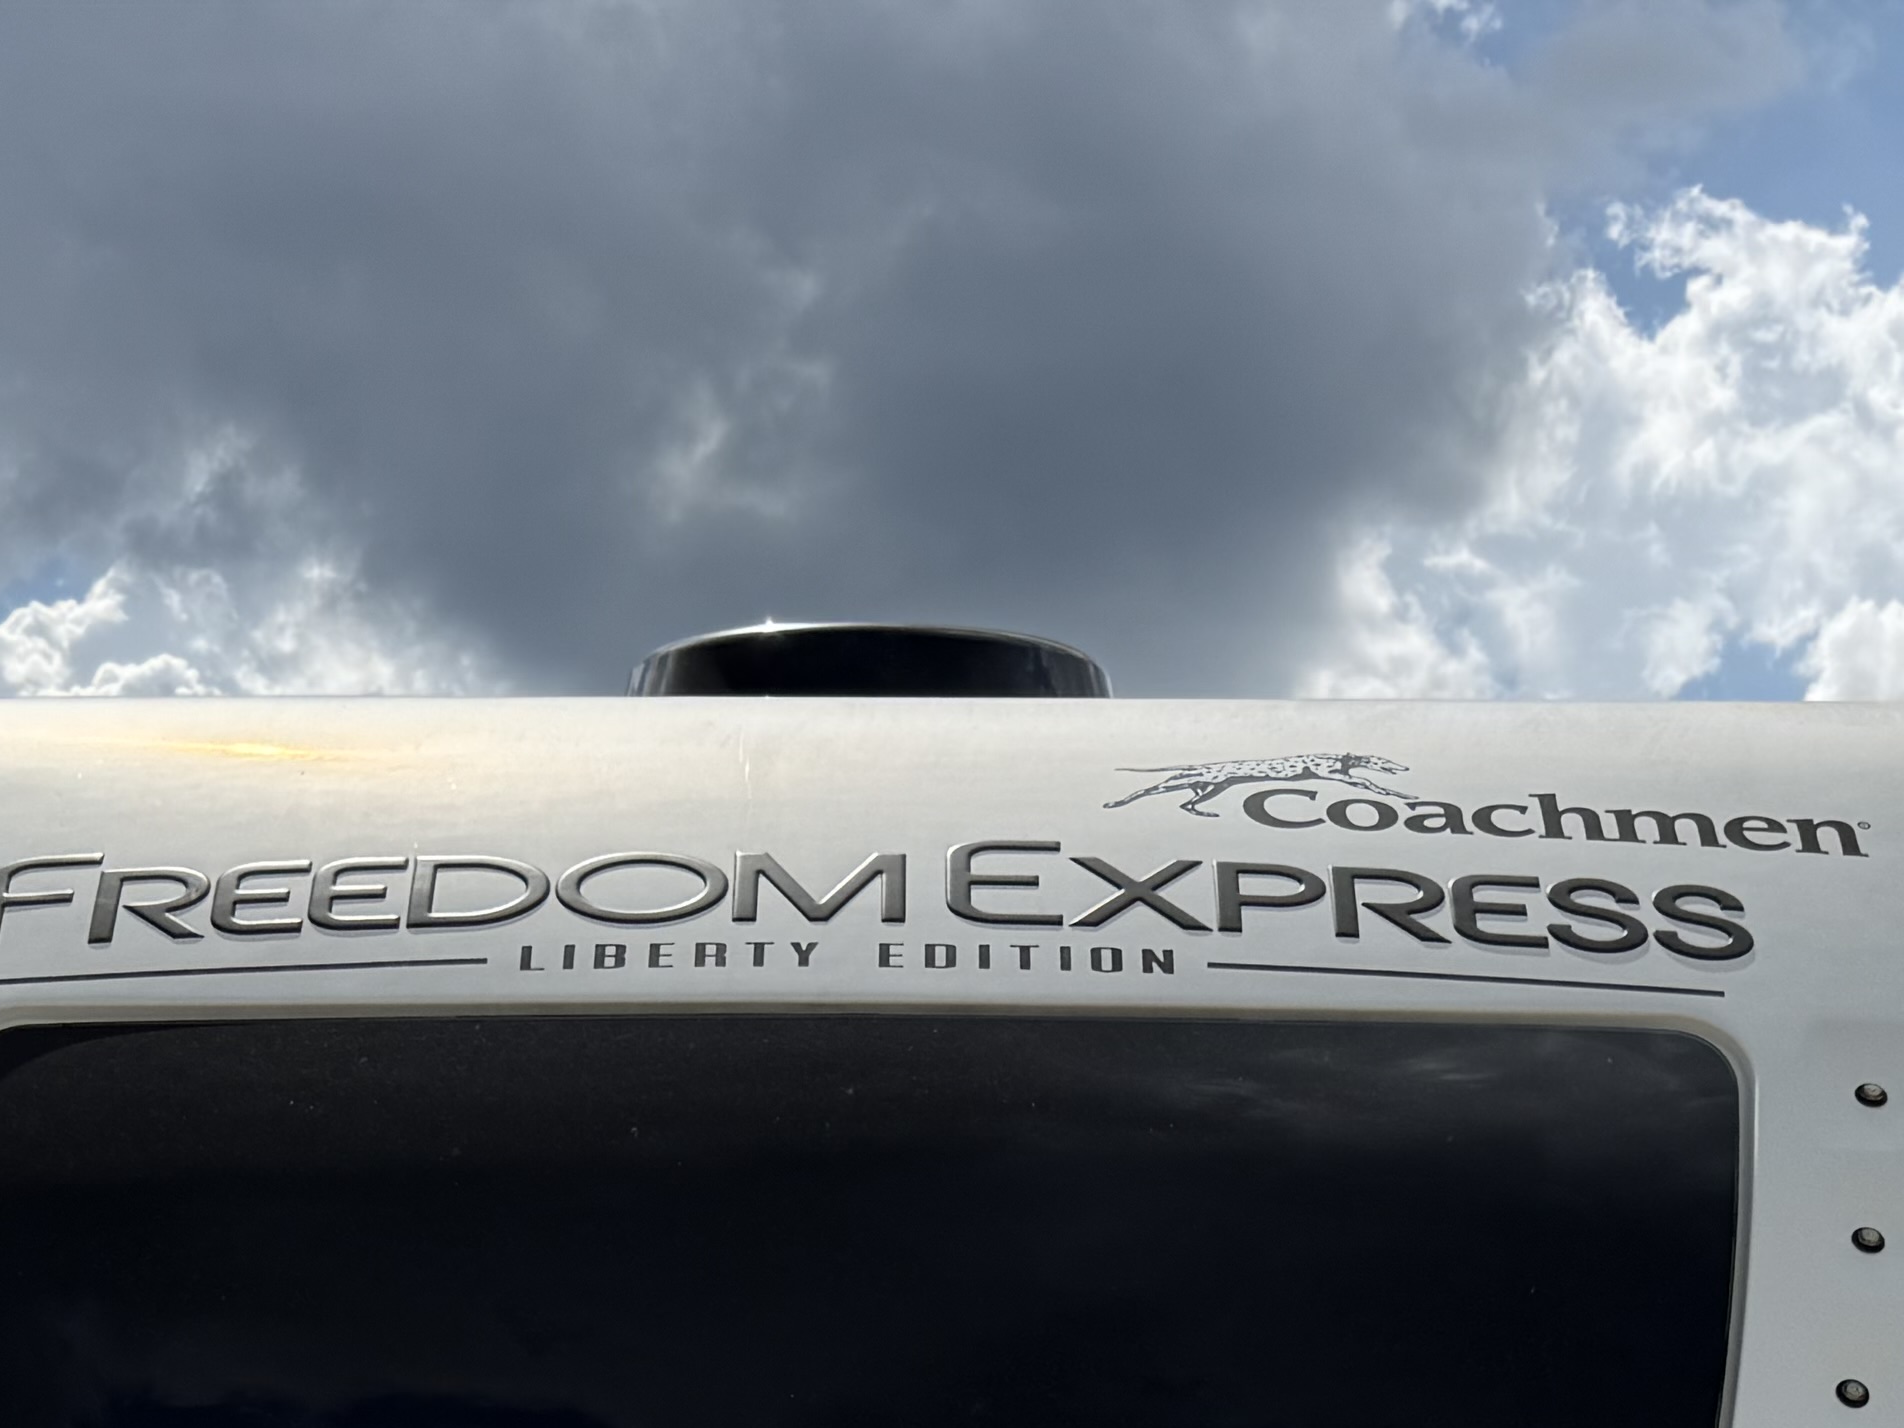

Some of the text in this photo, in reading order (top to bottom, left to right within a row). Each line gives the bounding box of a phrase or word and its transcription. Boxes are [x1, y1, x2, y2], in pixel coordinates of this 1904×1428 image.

[1242, 788, 1870, 858] Coachmen
[945, 840, 1754, 960] EXPRESS
[520, 941, 1174, 974] LIBERTY EDITION
